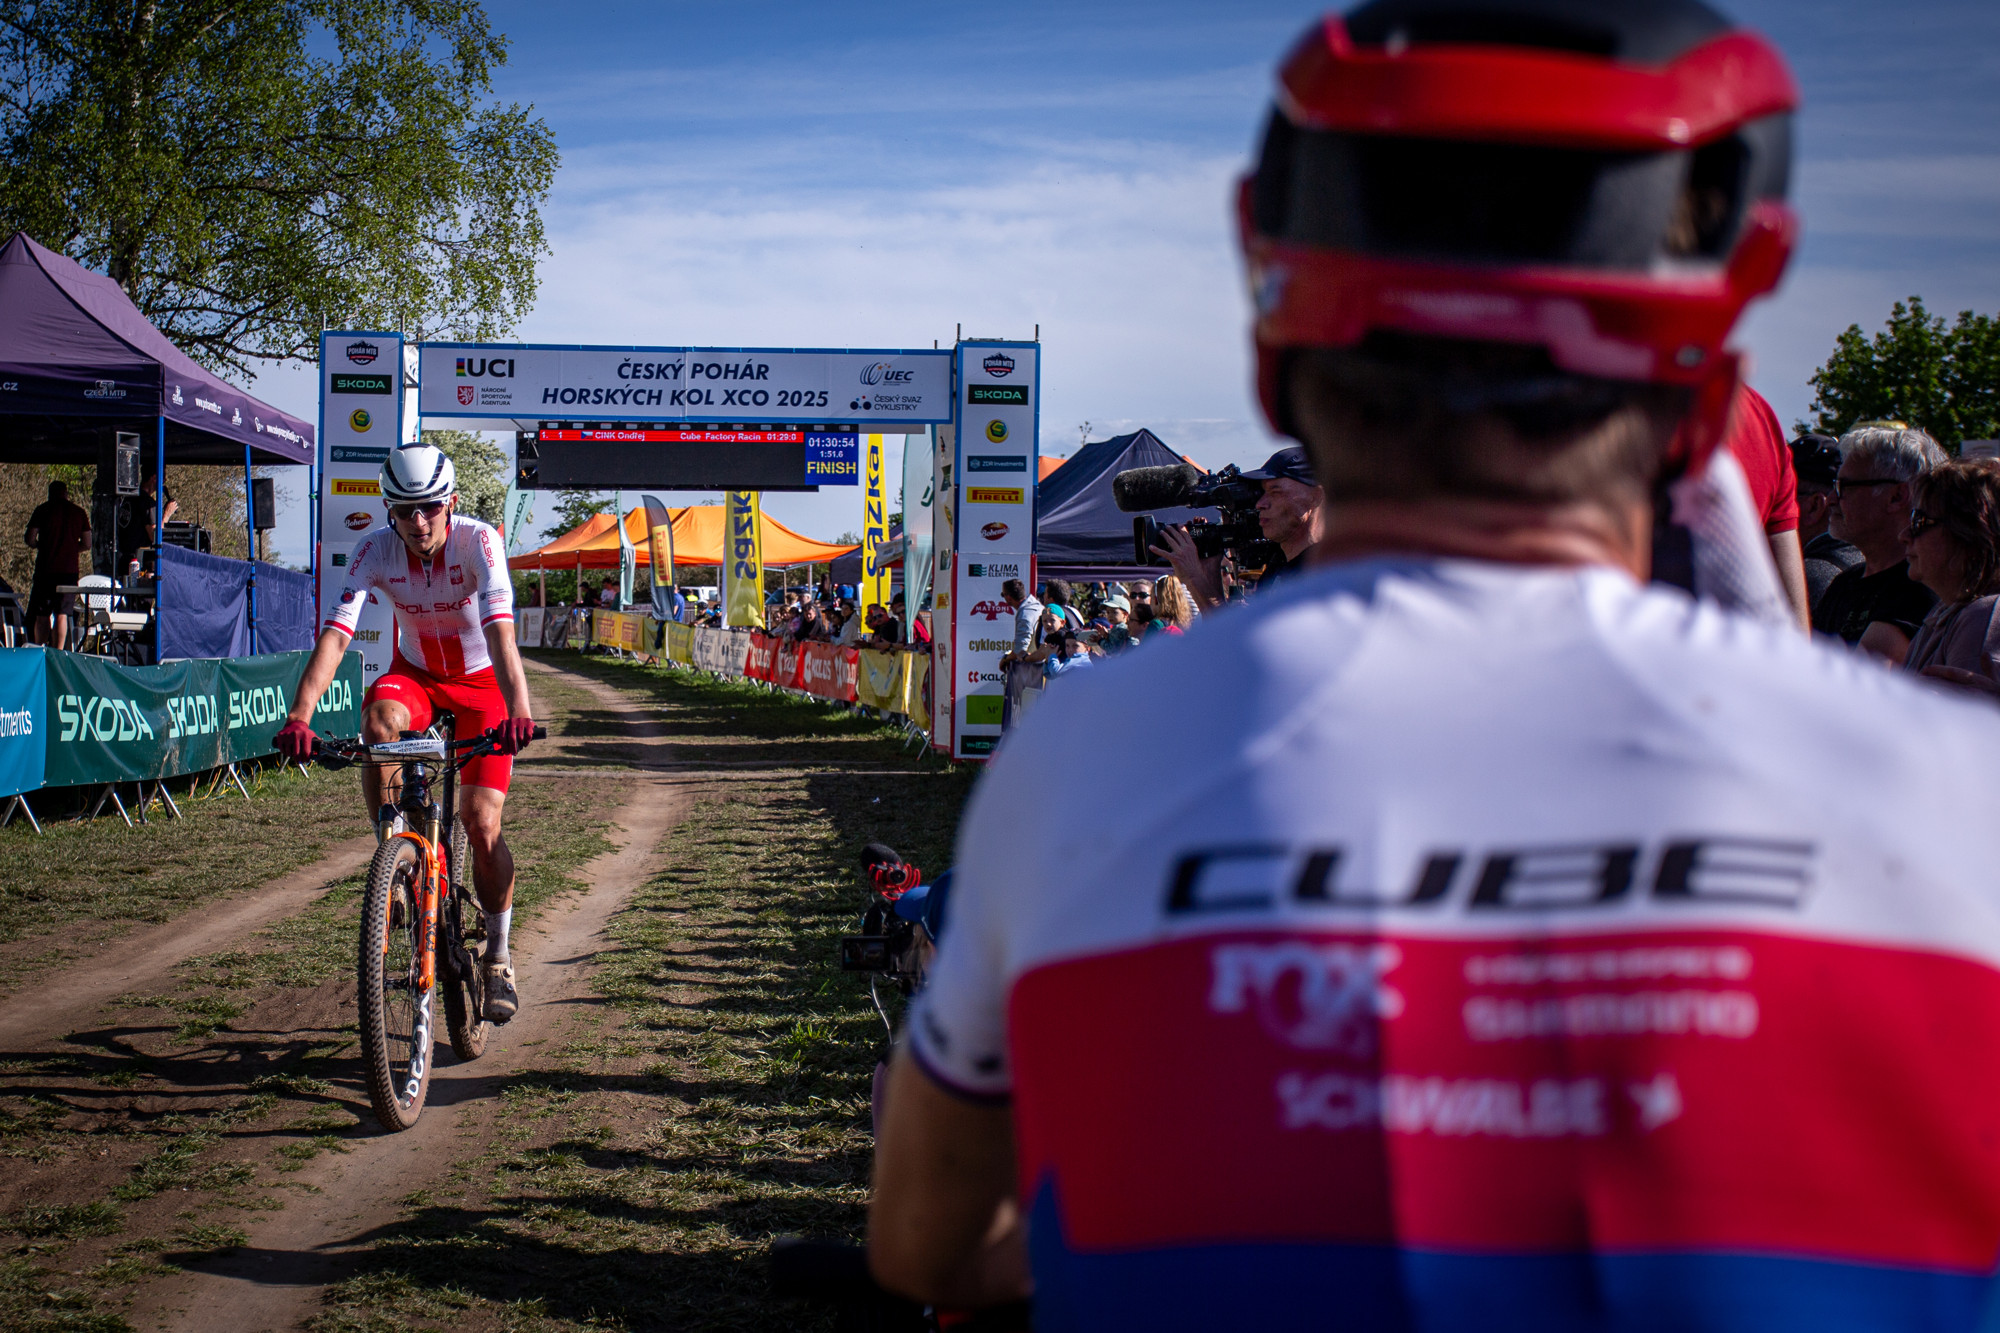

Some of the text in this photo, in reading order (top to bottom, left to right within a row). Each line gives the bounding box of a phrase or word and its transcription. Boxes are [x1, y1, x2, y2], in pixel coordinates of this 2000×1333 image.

[467, 358, 515, 378] UCI
[617, 358, 769, 380] ČESKÝ POHÁR
[884, 370, 914, 381] UEC
[541, 384, 829, 407] HORSKÝCH KOL XCO 2025
[874, 393, 922, 404] ČESKÝ SVAZ
[874, 403, 917, 411] CYKLISTIKY
[617, 431, 645, 442] Ondřej
[680, 432, 701, 440] Cube
[705, 433, 735, 442] Factory
[738, 433, 761, 441] Racin
[808, 438, 855, 447] 01:30:54
[807, 461, 857, 474] FINISH
[972, 490, 1019, 501] PIRELLI
[479, 529, 495, 568] POLSKA
[349, 541, 373, 576] POLSKA
[988, 563, 1019, 572] KLIMA
[395, 597, 472, 614] POLSKA
[1165, 836, 1815, 916] CUBE
[1208, 943, 1404, 1040] FOX
